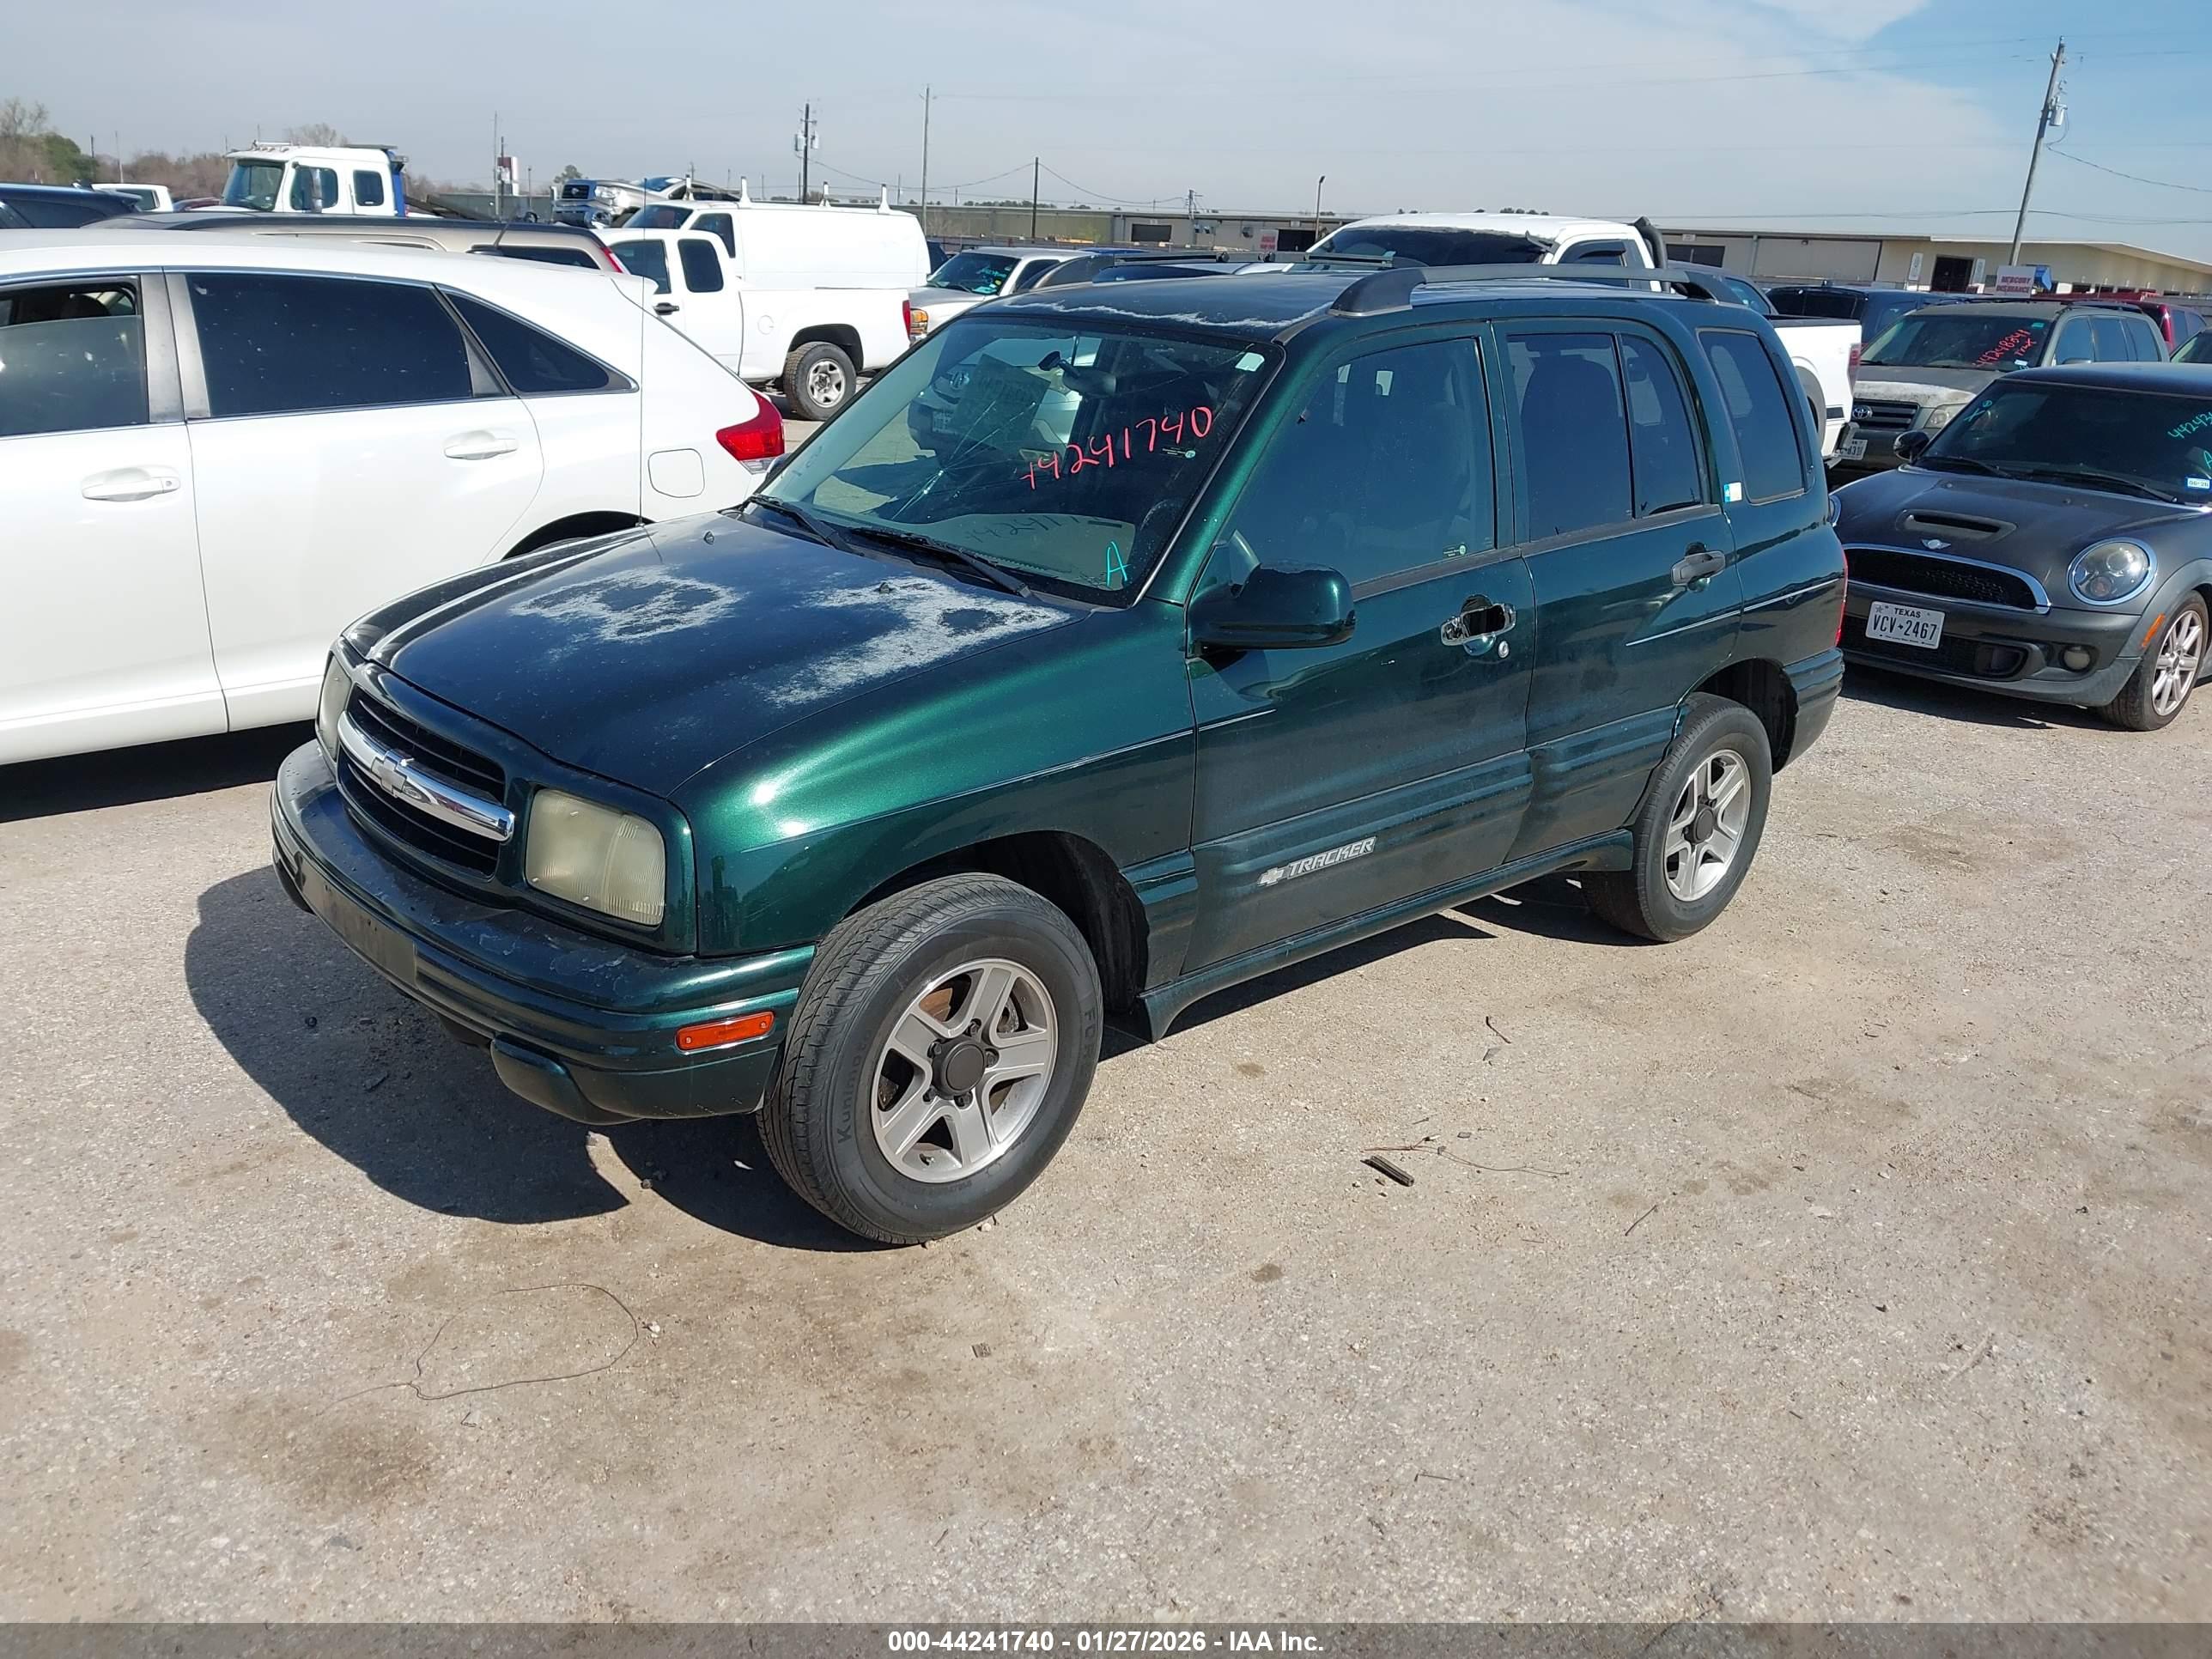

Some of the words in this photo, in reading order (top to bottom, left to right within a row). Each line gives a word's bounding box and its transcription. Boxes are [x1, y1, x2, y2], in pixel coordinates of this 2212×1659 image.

[1106, 540, 1132, 587] A
[1894, 607, 1922, 618] TEXAS
[1290, 837, 1376, 877] TRACKER
